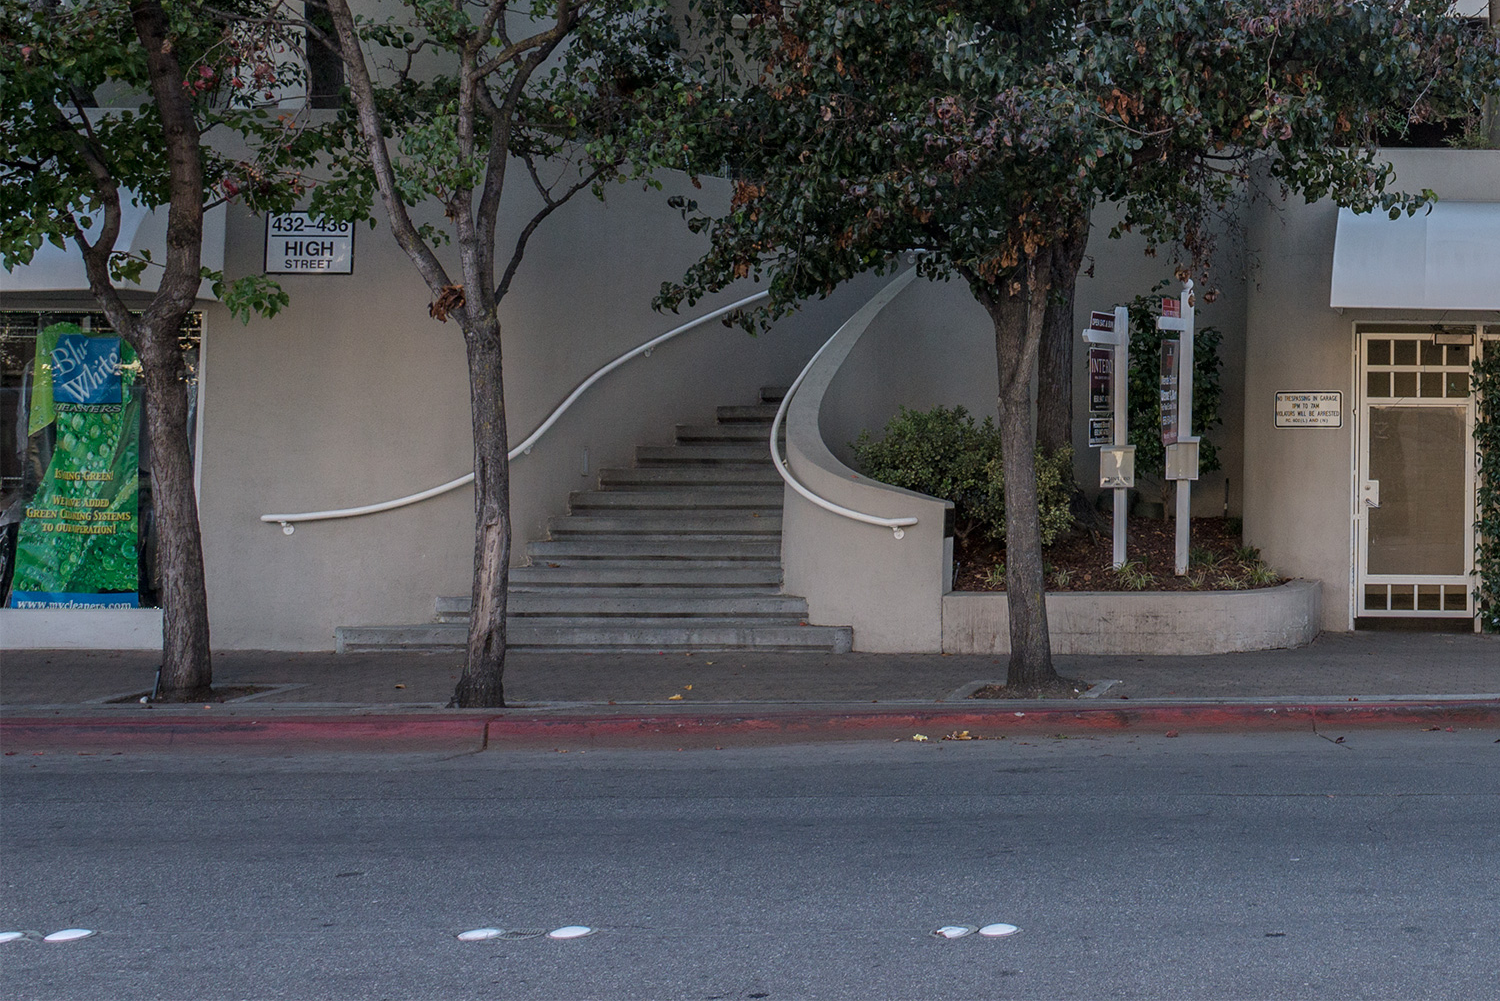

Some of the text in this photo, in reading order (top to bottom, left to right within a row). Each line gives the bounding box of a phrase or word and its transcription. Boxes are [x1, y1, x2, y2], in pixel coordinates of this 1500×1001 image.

[284, 241, 334, 256] HIGH
[284, 259, 333, 269] STREET
[83, 470, 114, 481] GREEN!
[83, 498, 110, 508] ADDED
[26, 508, 58, 519] GREEN
[93, 510, 131, 521] SYSTEMS
[42, 523, 54, 532] TO
[17, 600, 131, 609] www.mycleaners.com
